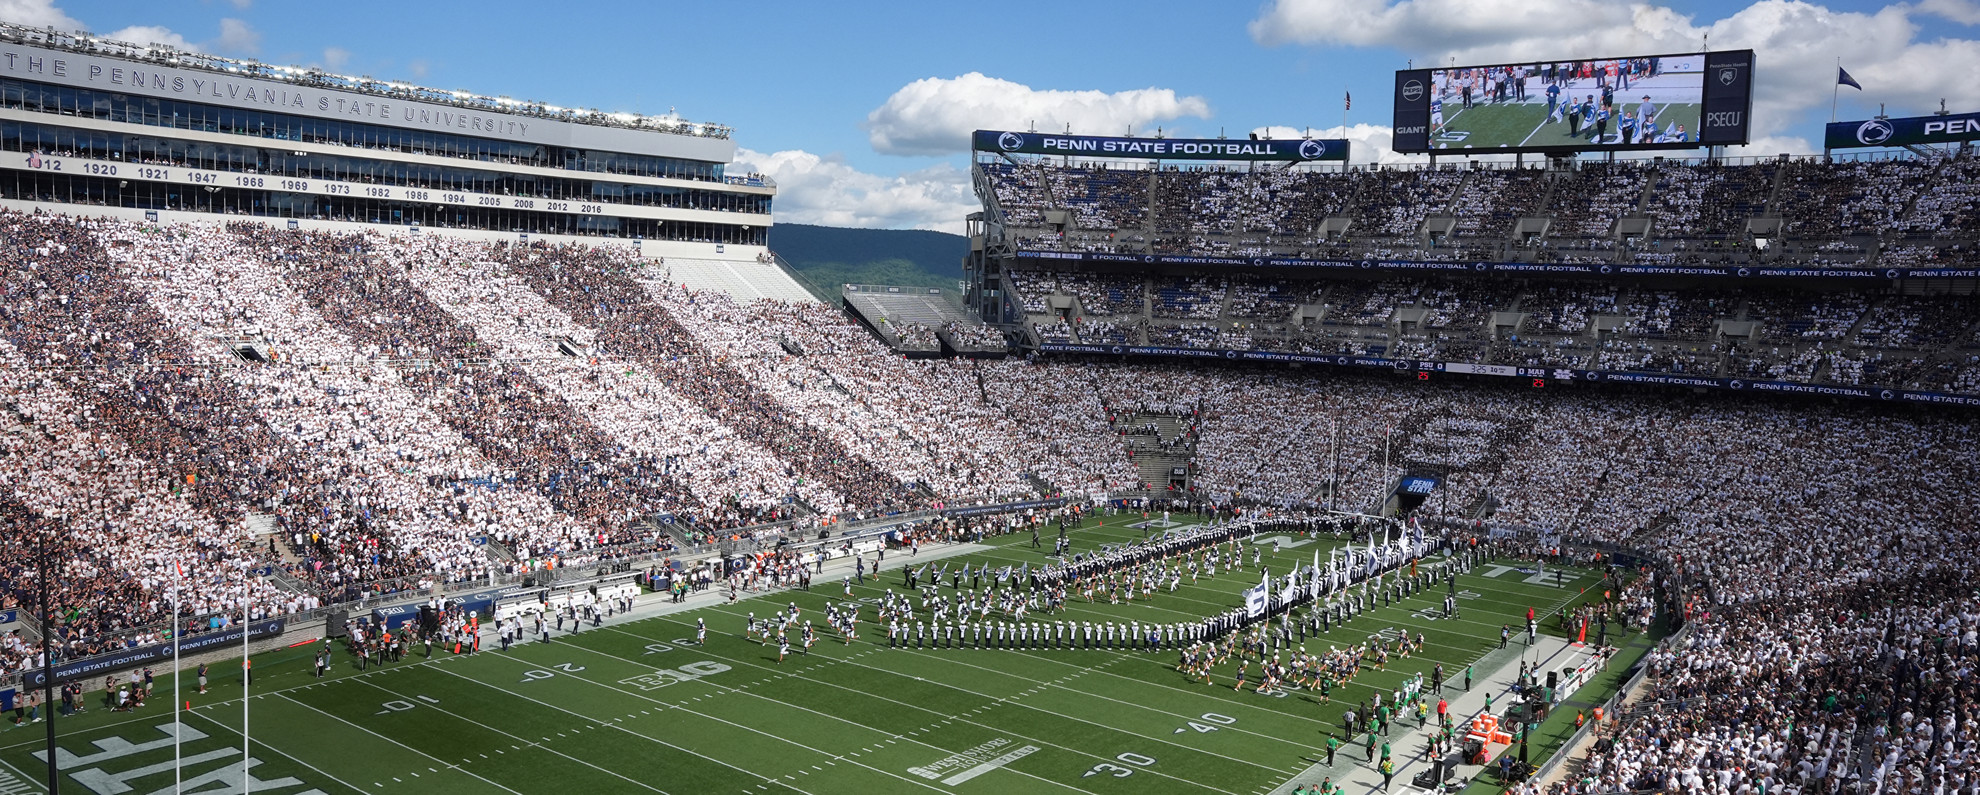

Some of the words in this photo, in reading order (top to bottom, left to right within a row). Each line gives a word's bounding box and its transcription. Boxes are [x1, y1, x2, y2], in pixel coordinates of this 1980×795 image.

[4, 52, 67, 77] THE
[89, 64, 304, 108] PENNSYLVANIA
[318, 96, 391, 119] STATE
[404, 107, 529, 136] UNIVERSITY
[1706, 112, 1741, 127] PSECU
[1397, 126, 1425, 134] GIANT
[1043, 139, 1097, 151] PENN
[1103, 141, 1166, 153] STATE
[1172, 143, 1277, 155] FOOTBALL
[84, 163, 117, 176] 1920
[138, 168, 168, 180] 1921
[188, 172, 217, 184] 1947
[235, 176, 264, 188] 1968
[281, 180, 308, 191] 1969
[324, 183, 350, 195] 1973
[365, 187, 390, 198] 1982
[405, 190, 429, 201] 1986
[442, 193, 465, 204] 1994
[479, 196, 501, 206] 2005
[514, 199, 534, 209] 2008
[547, 202, 568, 211] 2012
[581, 204, 602, 214] 2016
[1418, 372, 1428, 380] 25
[1471, 365, 1486, 373] 3:25
[1533, 379, 1544, 387] 25
[1668, 378, 1719, 386] FOOTBALL
[1783, 385, 1815, 393] STATE
[1817, 387, 1870, 397] FOOTBALL
[1933, 396, 1964, 404] STATE
[179, 641, 200, 651] PENN
[201, 636, 225, 646] STATE
[57, 668, 81, 678] PENN
[83, 660, 110, 672] STATE
[112, 652, 155, 666] FOOTBALL
[1186, 712, 1238, 734] 40
[924, 754, 965, 772] WEST
[963, 737, 1012, 757] SHORE
[1093, 752, 1157, 778] 30
